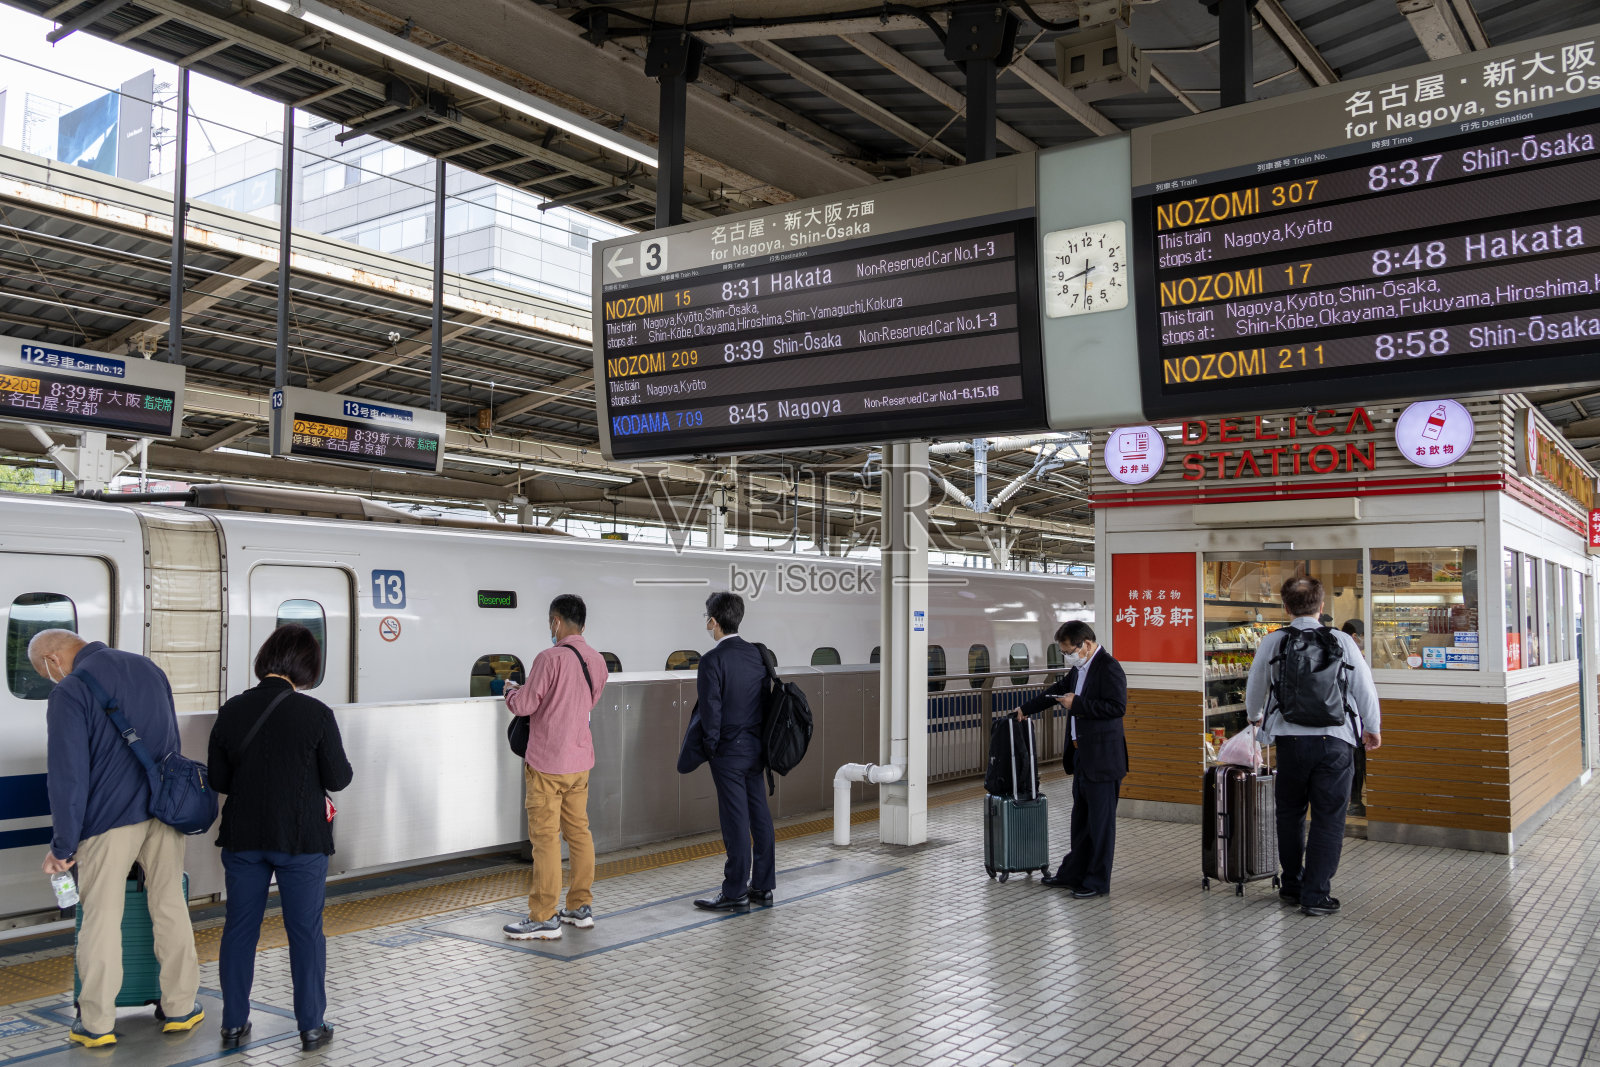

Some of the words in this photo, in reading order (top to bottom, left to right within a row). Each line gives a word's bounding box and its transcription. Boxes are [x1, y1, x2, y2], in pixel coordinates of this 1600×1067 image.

[1345, 120, 1377, 139] for
[1386, 100, 1486, 131] Nagoya,
[1460, 122, 1480, 132] 行先
[1481, 111, 1533, 128] Destination
[1371, 140, 1391, 150] 時刻
[1392, 136, 1413, 146] Time
[1257, 159, 1291, 172] 列車番号
[1292, 156, 1312, 165] Train
[1314, 153, 1328, 161] No.
[1155, 181, 1179, 191] 列車名
[1180, 178, 1198, 187] Train
[1157, 187, 1259, 231] NOZOMI
[1271, 179, 1319, 207] 307
[1368, 154, 1443, 192] 8:37
[1462, 132, 1595, 172] Shin-Ōsaka
[710, 247, 728, 261] for
[732, 239, 785, 257] Nagoya,
[790, 220, 871, 249] Shin-Ōsaka
[1081, 237, 1092, 247] 12
[1098, 239, 1104, 248] 1
[1157, 234, 1183, 250] This
[1184, 228, 1212, 245] train
[932, 251, 952, 265] Car
[954, 241, 995, 261] No.1-3
[1069, 243, 1078, 253] 11
[1108, 247, 1115, 258] 2
[646, 242, 662, 271] 3
[1060, 255, 1071, 265] 10
[1159, 251, 1192, 269] stops
[1194, 247, 1212, 261] at:
[1112, 262, 1119, 272] 3
[1160, 267, 1263, 308] NOZOMI
[1284, 263, 1313, 286] 17
[1372, 241, 1447, 276] 8:48
[1465, 223, 1585, 262] Hakata
[1058, 271, 1065, 281] 9
[1109, 277, 1116, 287] 4
[605, 292, 664, 320] NOZOMI
[675, 290, 691, 307] 15
[722, 279, 759, 301] 8:31
[771, 266, 832, 293] Hakata
[1062, 284, 1069, 294] 8
[1100, 289, 1107, 299] 5
[1072, 293, 1079, 303] 7
[1086, 295, 1093, 305] 6
[934, 319, 955, 335] Car
[957, 312, 997, 332] No.1-3
[1160, 310, 1186, 327] This
[1187, 306, 1214, 324] train
[606, 323, 621, 335] This
[621, 321, 637, 334] train
[1162, 329, 1195, 345] stops
[1197, 326, 1215, 340] at:
[607, 336, 626, 349] stops
[1163, 348, 1267, 385] NOZOMI
[1278, 344, 1324, 368] 211
[1375, 328, 1450, 361] 8:58
[1469, 315, 1600, 349] Shin-Ōsaka
[23, 347, 75, 368] 12号車
[77, 361, 94, 371] Car
[96, 363, 123, 375] No.12
[607, 351, 666, 378] NOZOMI
[672, 350, 698, 368] 209
[724, 339, 764, 363] 8:39
[773, 332, 842, 355] Shin-Ōsaka
[609, 381, 624, 393] This
[624, 379, 640, 391] train
[51, 382, 87, 400] 8:39
[88, 387, 142, 409] 新大阪
[143, 395, 173, 412] 指定席
[272, 392, 283, 408] 13
[611, 394, 630, 407] stops
[922, 391, 938, 403] Car
[345, 402, 379, 418] 13号車
[612, 411, 671, 436] KODAMA
[676, 410, 703, 428] 709
[728, 402, 769, 425] 8:45
[778, 399, 842, 419] Nagoya
[1182, 407, 1376, 446] DELICA
[294, 421, 347, 439] のぞみ209
[354, 430, 379, 444] 8:39
[380, 432, 416, 449] 新大阪
[1415, 444, 1454, 456] お飲物
[1119, 463, 1150, 475] お弁当
[375, 574, 403, 605] 13
[1128, 589, 1181, 600] 横濱名物
[478, 594, 511, 606] Reserved
[1115, 604, 1194, 628] 崎陽軒
